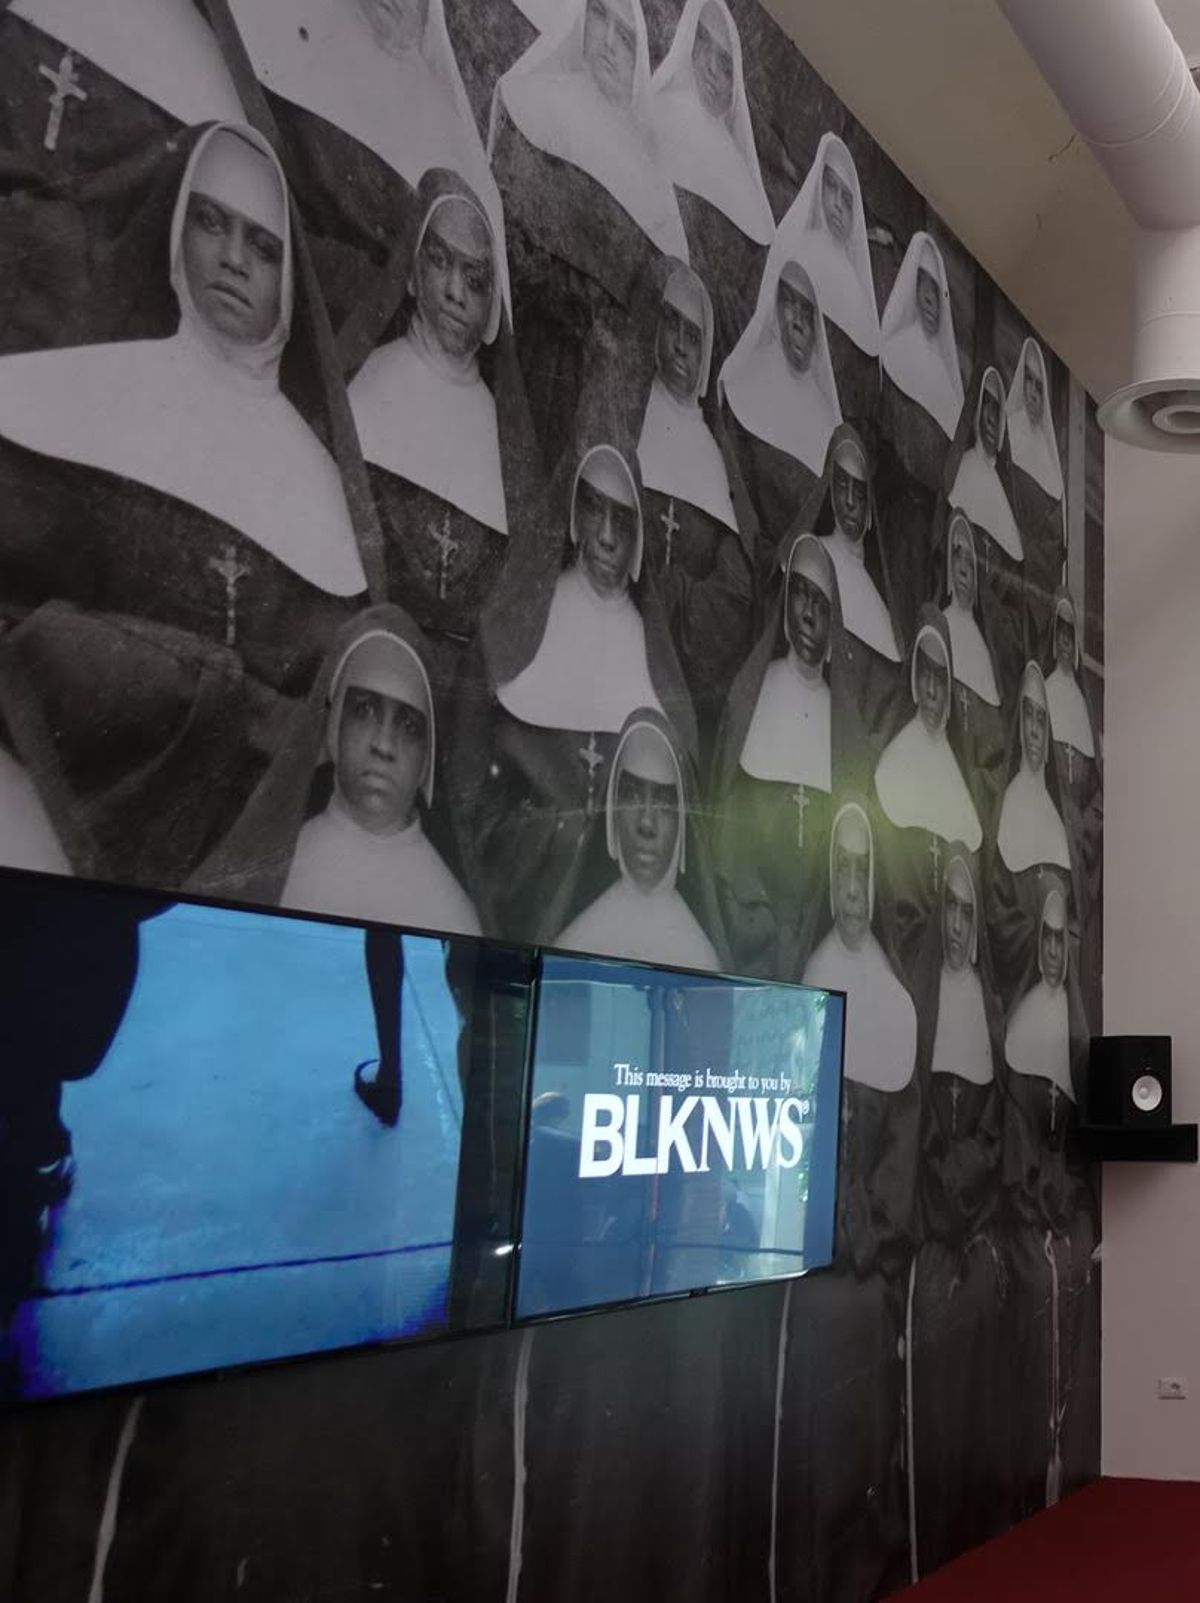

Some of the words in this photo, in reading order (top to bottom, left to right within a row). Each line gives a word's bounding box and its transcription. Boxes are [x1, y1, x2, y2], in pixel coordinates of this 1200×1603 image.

[613, 1063, 643, 1086] This
[646, 1070, 692, 1092] message
[694, 1070, 704, 1088] is
[706, 1068, 746, 1094] brought
[748, 1077, 760, 1090] to
[761, 1077, 779, 1095] you
[780, 1071, 792, 1094] by
